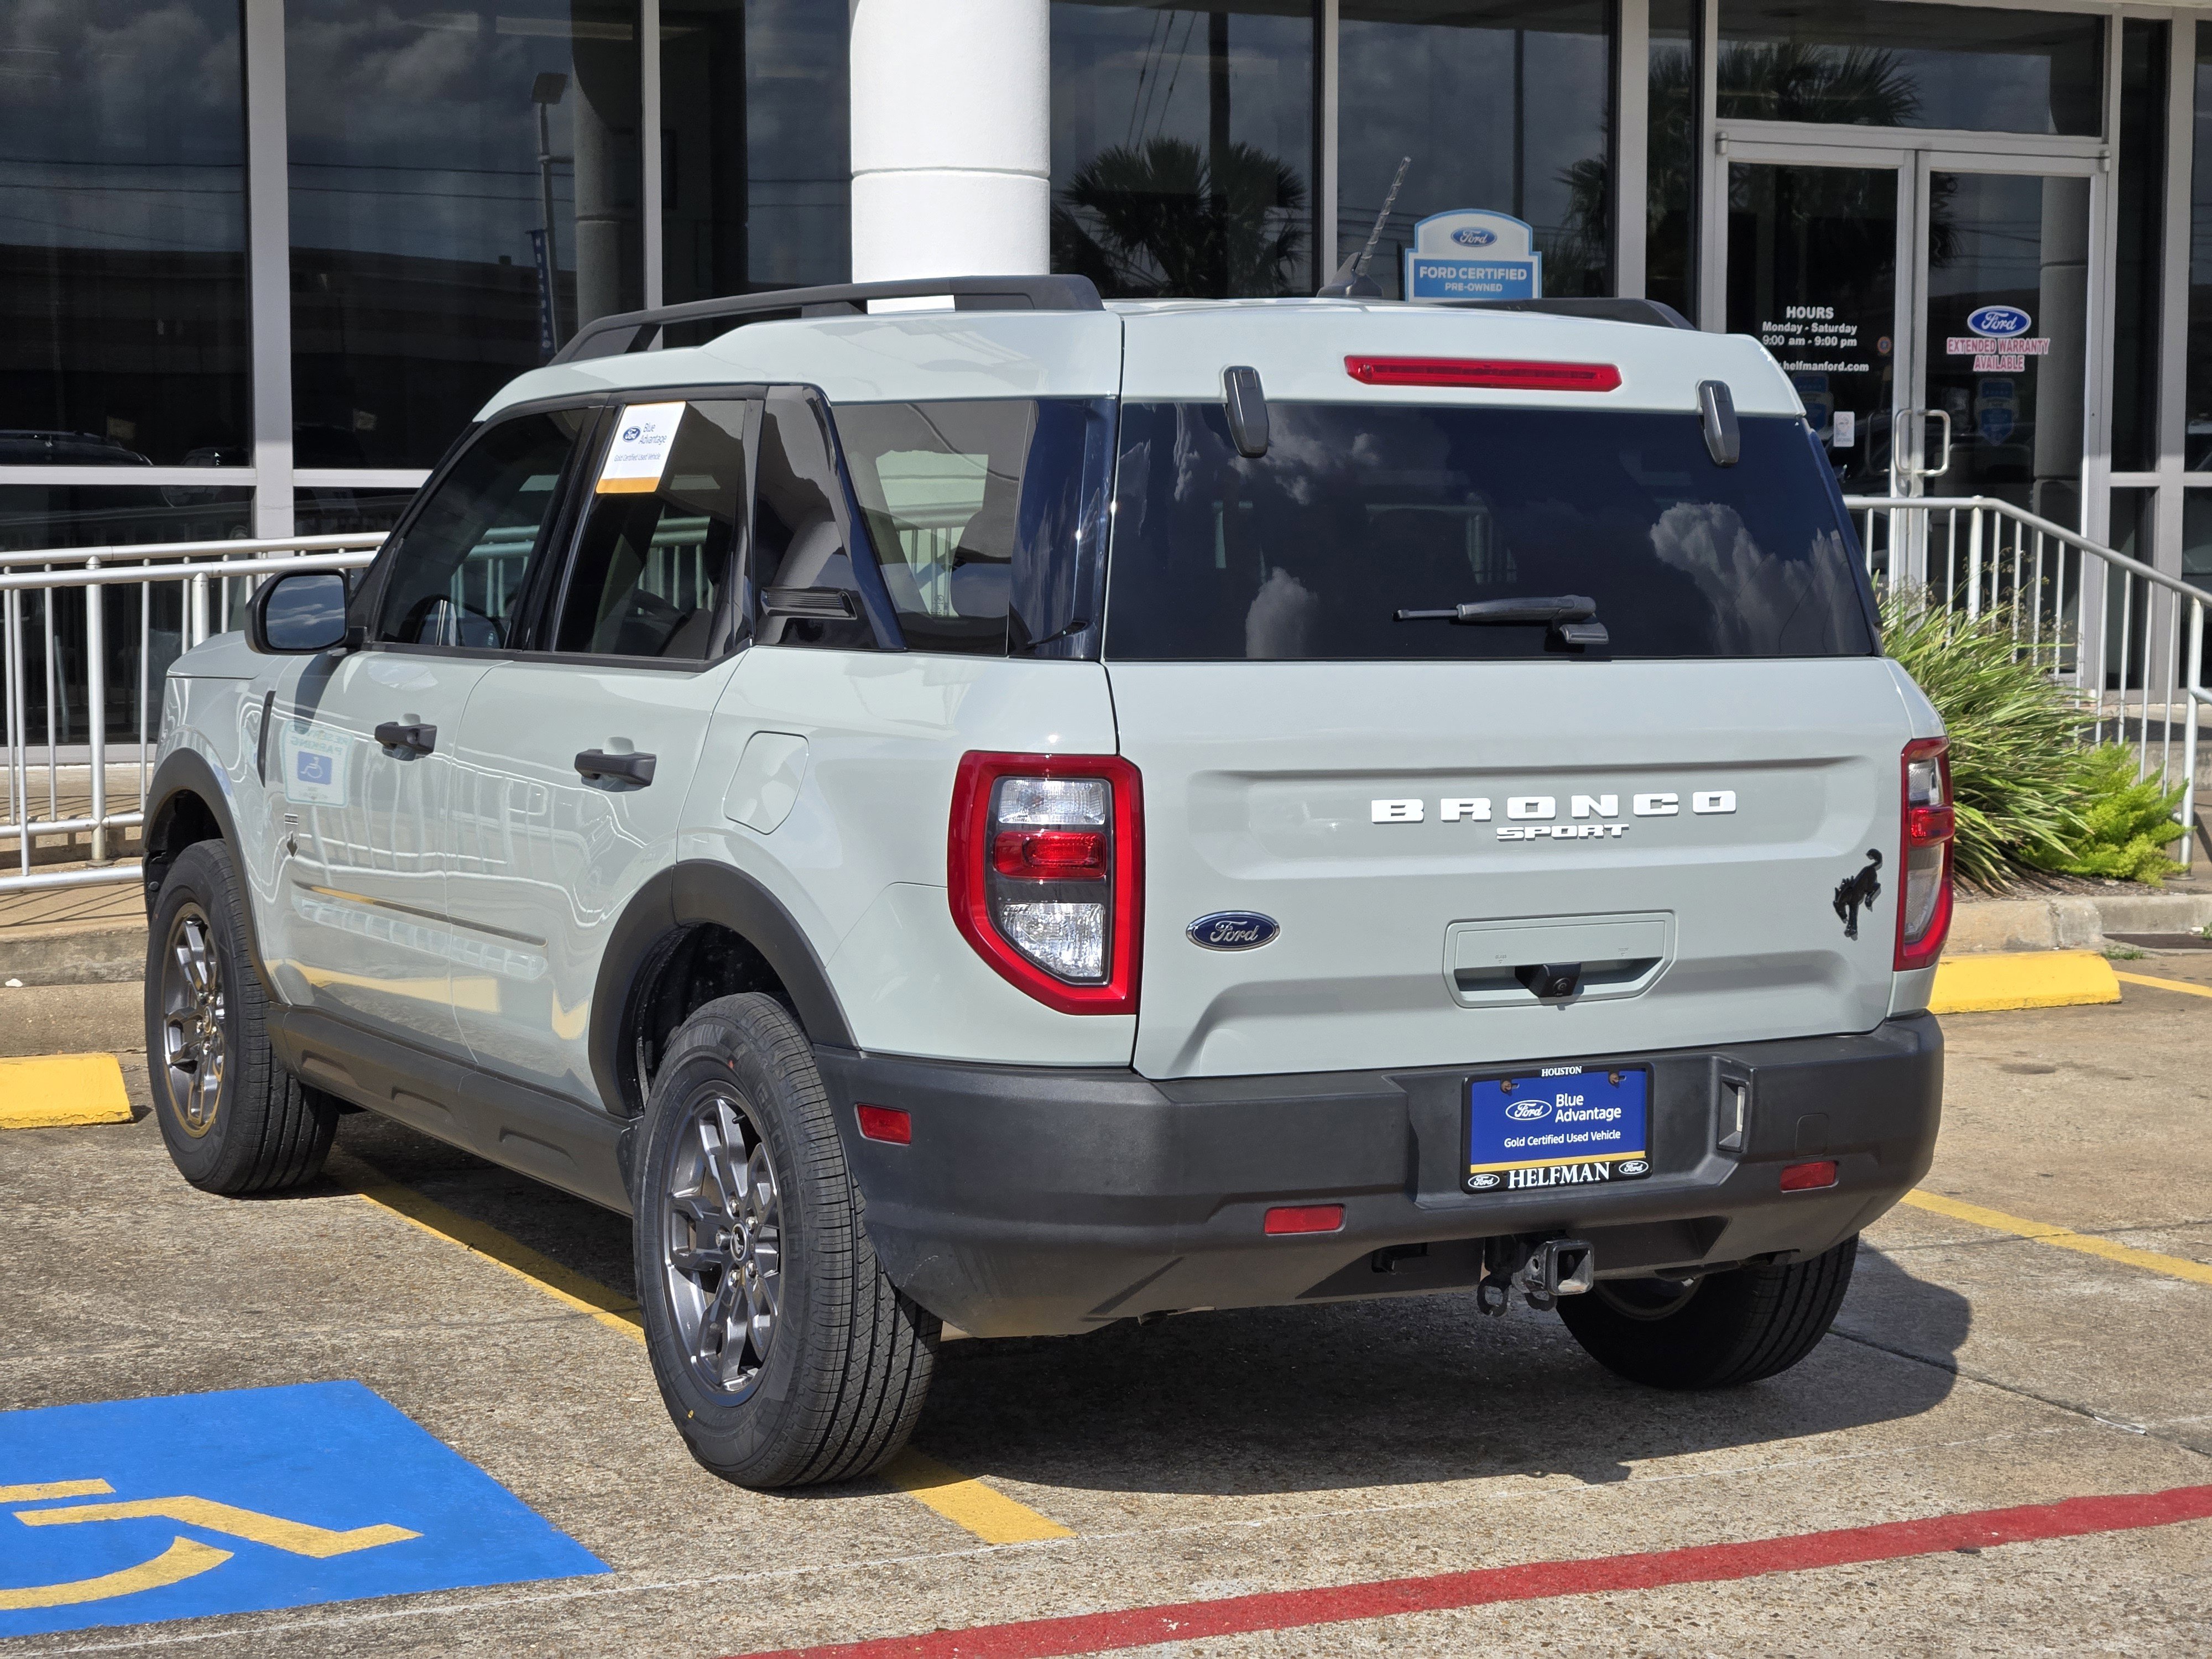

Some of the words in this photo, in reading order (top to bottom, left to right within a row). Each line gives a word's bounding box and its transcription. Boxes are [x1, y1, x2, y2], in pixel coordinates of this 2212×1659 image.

[1459, 230, 1488, 243] Ford
[1420, 267, 1457, 279] FORD
[1458, 268, 1527, 281] CERTIFIED
[1445, 283, 1503, 292] PRE-OWNED
[1786, 306, 1834, 319] HOURS
[1762, 321, 1803, 334] Monday
[1811, 322, 1858, 335] Saturday
[1981, 311, 2017, 331] Ford
[1762, 335, 1785, 346] 9:00
[1788, 336, 1806, 346] am
[1814, 336, 1838, 346] 9:00
[1840, 338, 1858, 348] pm
[1947, 338, 1996, 354] EXTENDED
[1998, 338, 2049, 354] WARRANTY
[1779, 361, 1869, 372] helfmanford.com
[1974, 356, 2025, 372] AVAILABLE
[643, 423, 656, 432] Blue
[639, 434, 667, 445] Advantage
[1371, 790, 1736, 823] BRONCO
[1496, 824, 1629, 840] SPORT
[1210, 920, 1260, 942] Ford
[1541, 1066, 1582, 1077] HOUSTON
[1556, 1093, 1584, 1107] Blue
[1514, 1103, 1544, 1117] Ford
[1555, 1106, 1622, 1123] Advantage
[1504, 1138, 1525, 1147] Gold
[1527, 1134, 1564, 1146] Certified
[1566, 1133, 1589, 1143] Used
[1590, 1129, 1621, 1141] Vehicle
[1473, 1176, 1495, 1186] Ford
[1507, 1162, 1610, 1189] HELFMAN
[1623, 1162, 1645, 1172] Ford
